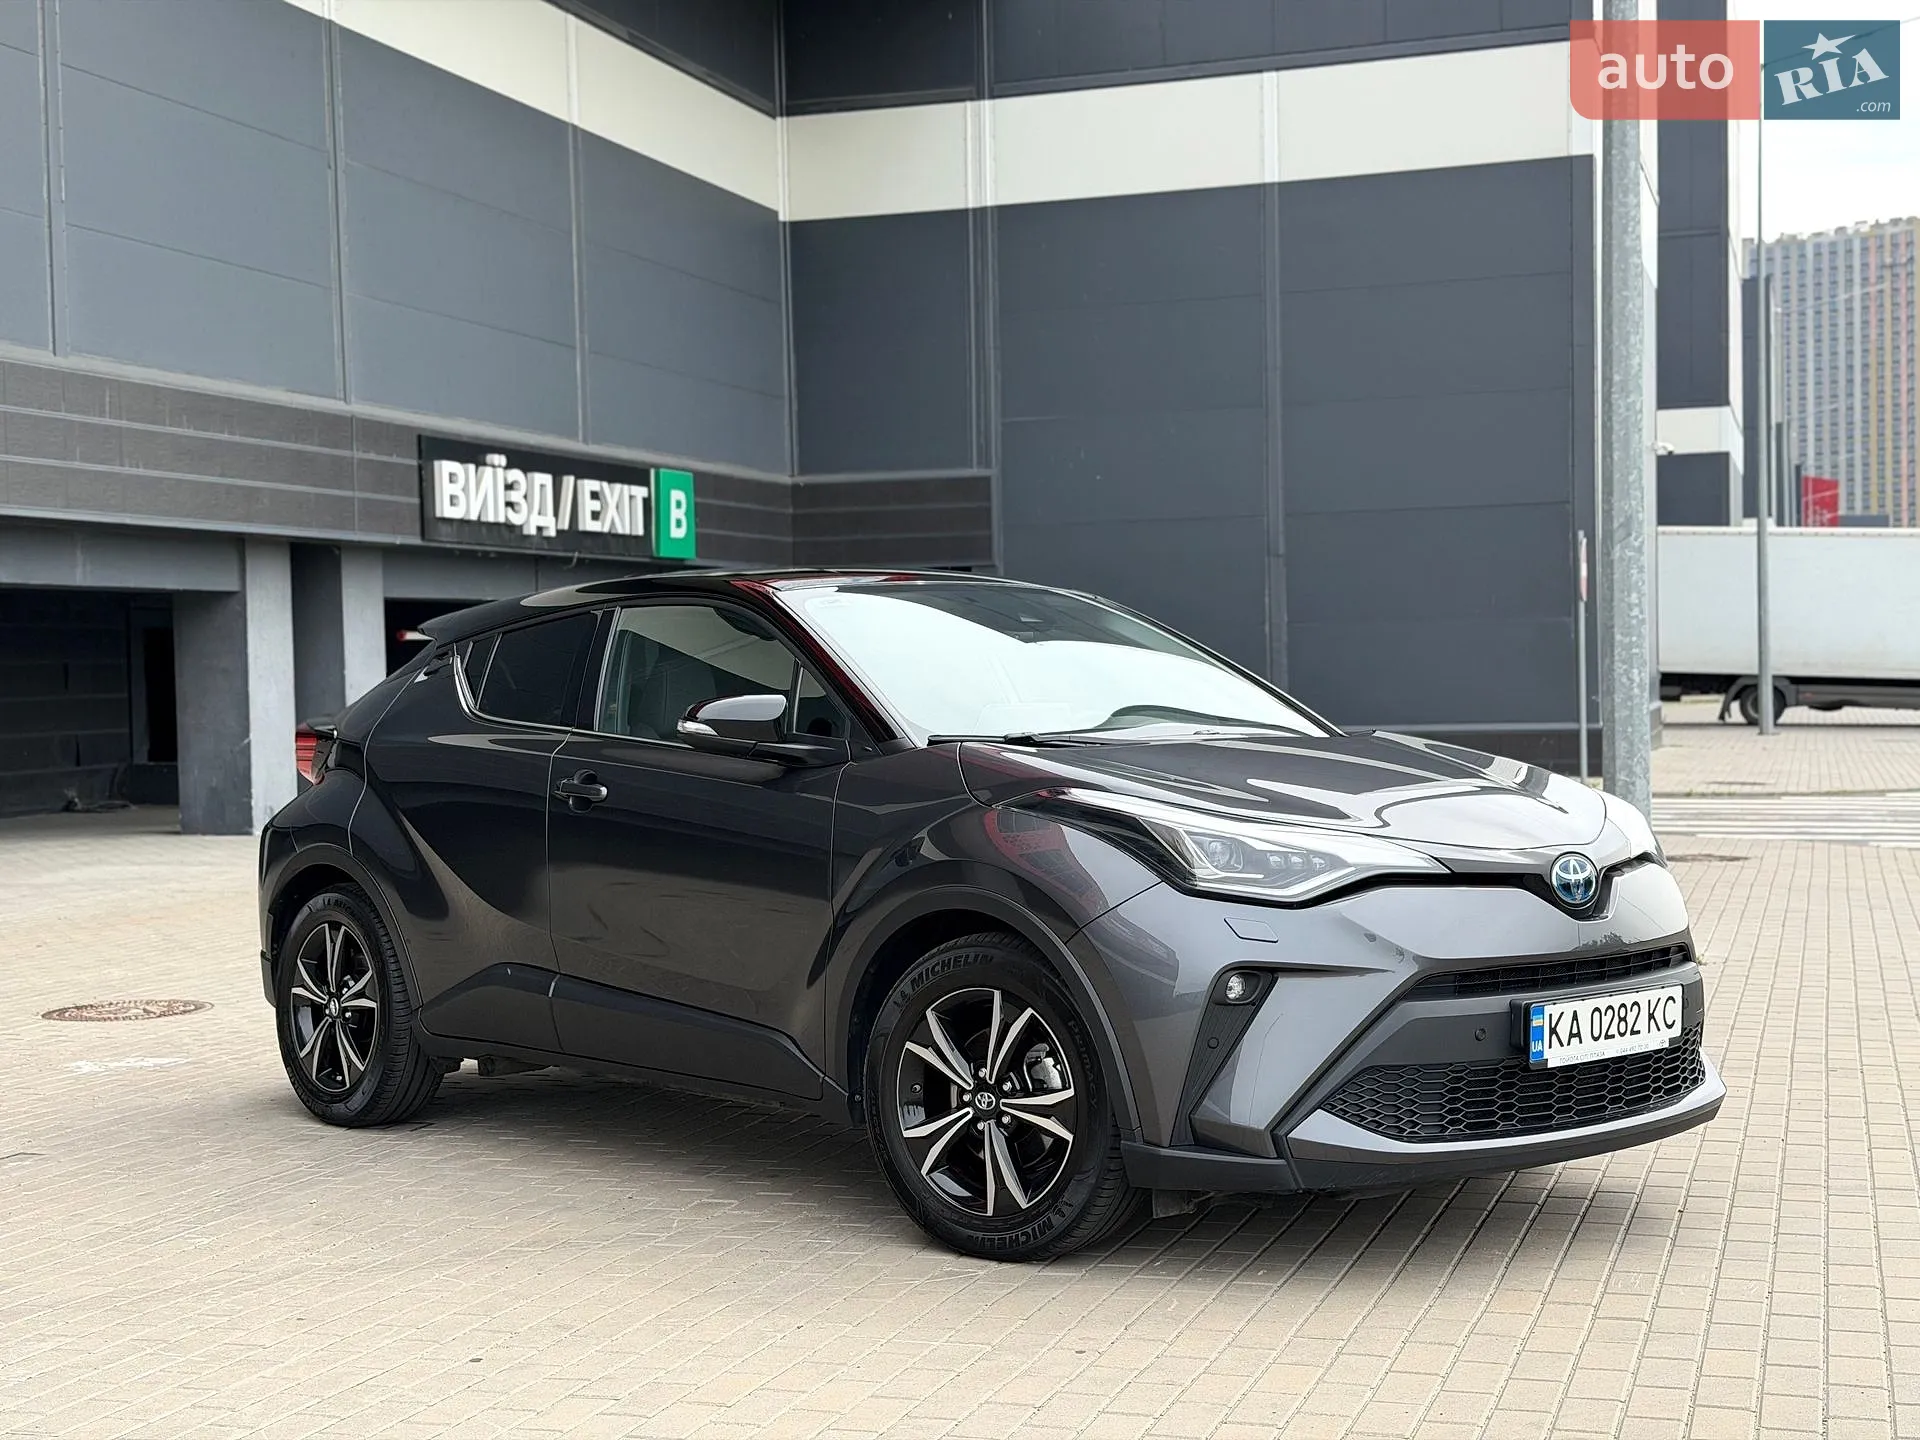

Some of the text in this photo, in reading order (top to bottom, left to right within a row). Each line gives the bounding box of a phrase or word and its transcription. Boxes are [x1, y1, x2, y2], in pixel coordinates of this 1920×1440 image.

[910, 953, 994, 992] MICHELIN
[1548, 995, 1677, 1050] KA 0282 KC
[1531, 1040, 1543, 1052] UA
